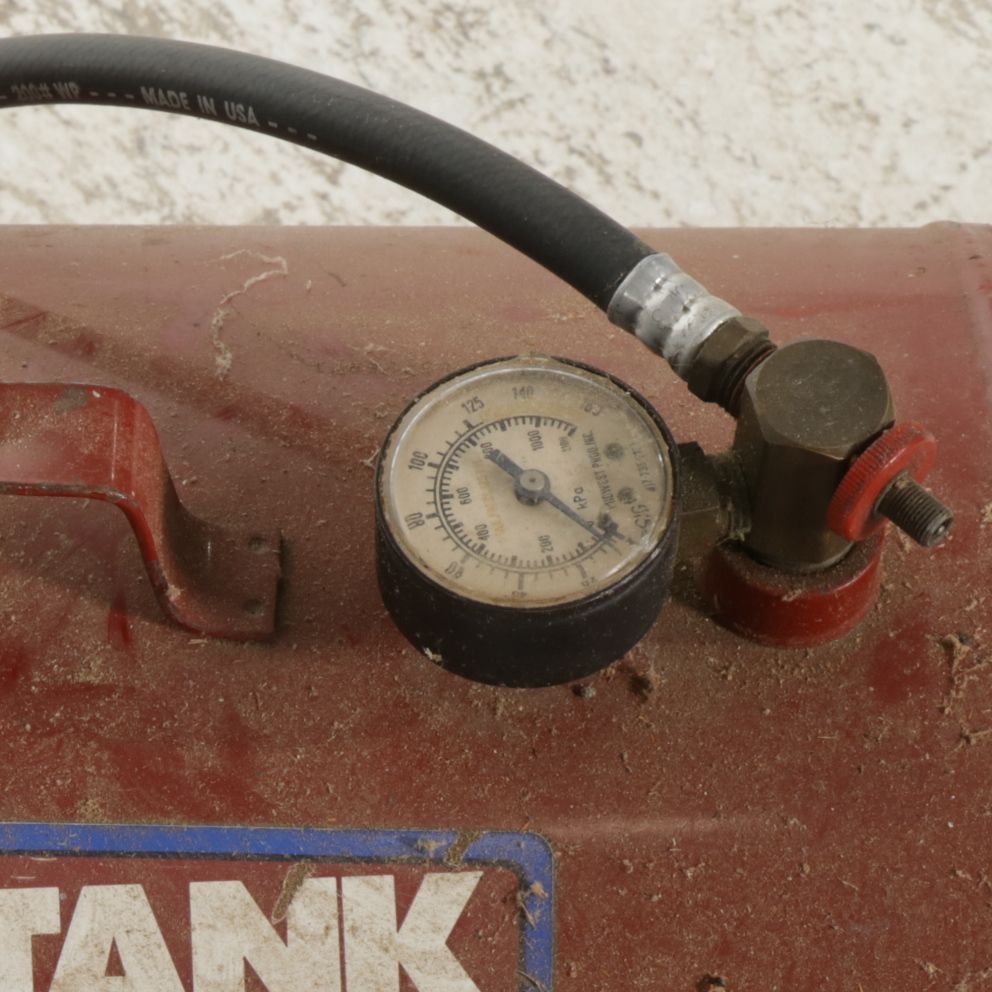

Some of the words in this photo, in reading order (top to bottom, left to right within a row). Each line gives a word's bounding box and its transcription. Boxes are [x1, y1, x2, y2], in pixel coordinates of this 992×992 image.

[140, 86, 191, 110] MADE
[197, 95, 217, 116] IN
[224, 101, 260, 126] USA
[512, 386, 534, 399] 140
[462, 396, 485, 414] 125
[527, 429, 544, 451] 1000
[409, 451, 428, 471] 100
[456, 486, 472, 505] 600
[574, 487, 587, 510] kPa
[405, 512, 425, 530] 80
[475, 524, 490, 541] 400
[538, 535, 554, 553] 200
[444, 562, 464, 578] 60
